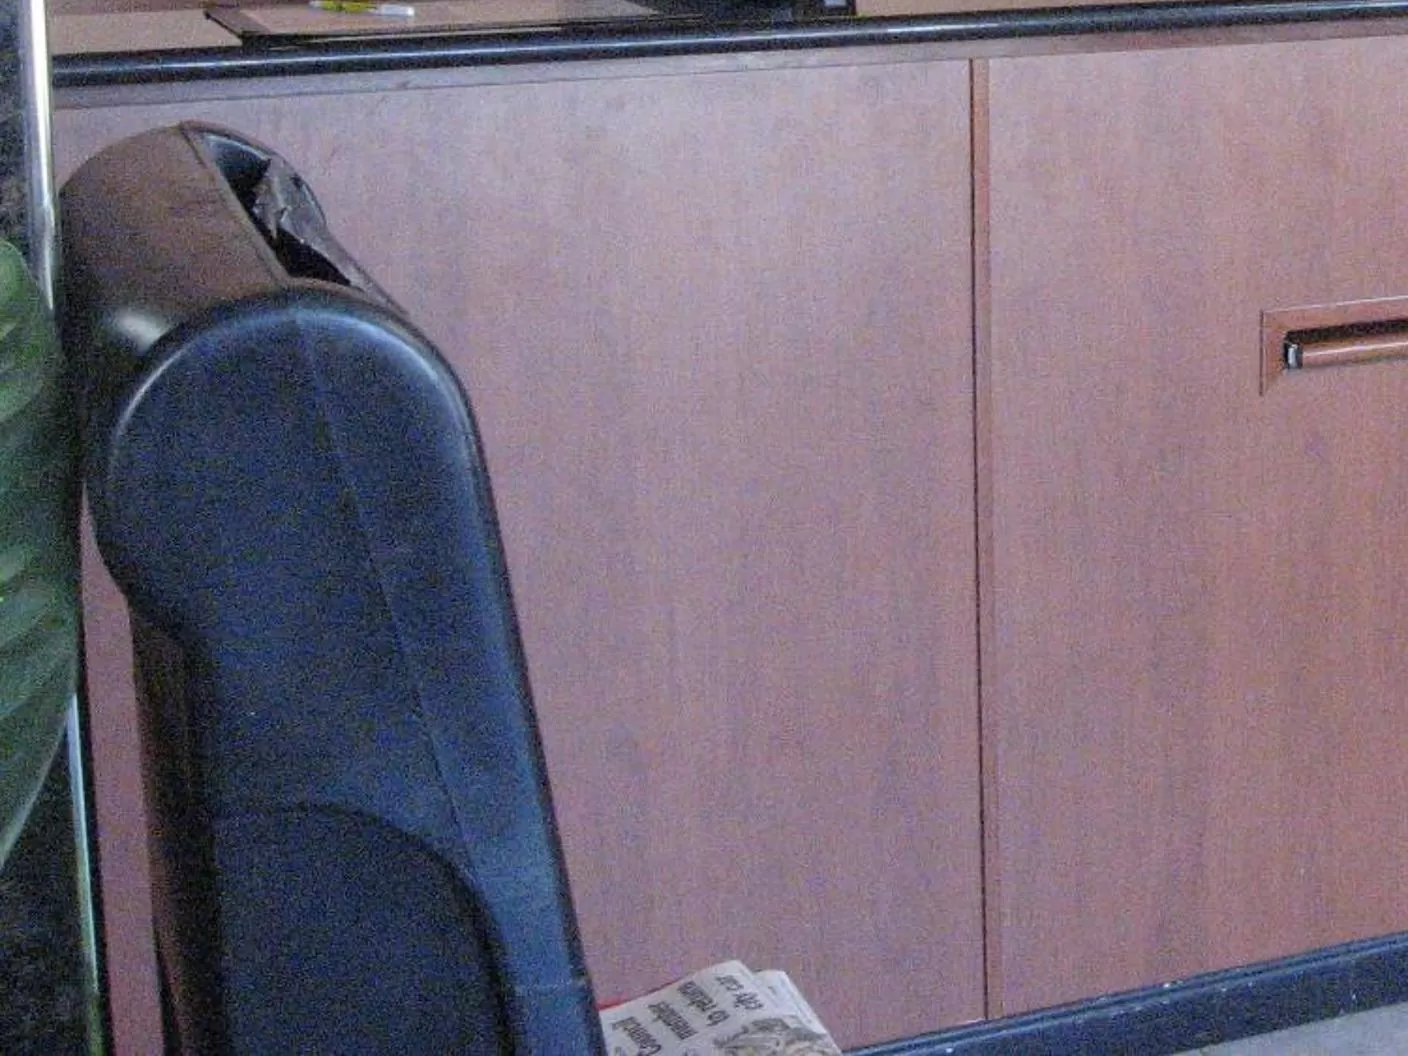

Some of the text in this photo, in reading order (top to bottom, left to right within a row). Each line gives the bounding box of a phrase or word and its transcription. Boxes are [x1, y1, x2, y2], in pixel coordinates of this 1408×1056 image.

[648, 1001, 698, 1040] member
[676, 980, 730, 1027] to return
